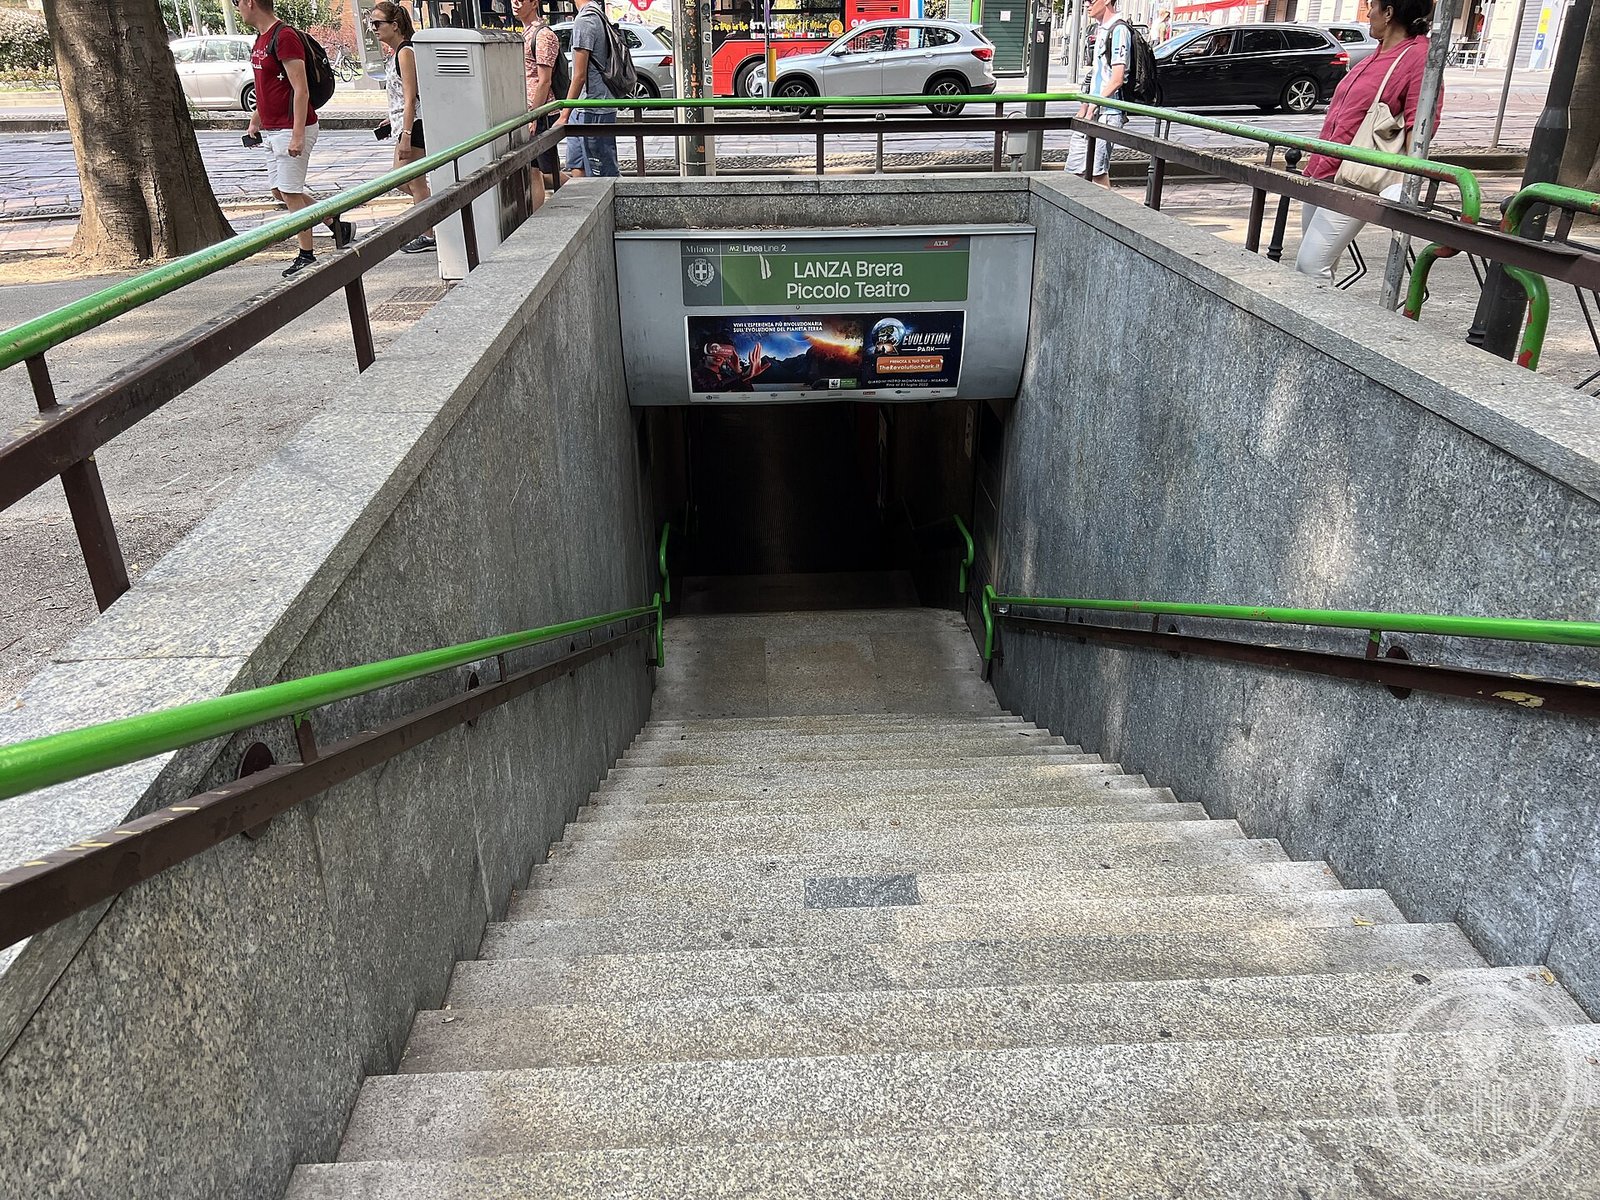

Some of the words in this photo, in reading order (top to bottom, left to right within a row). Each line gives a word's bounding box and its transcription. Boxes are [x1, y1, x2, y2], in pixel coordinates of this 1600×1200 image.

[686, 245, 714, 253] Milano
[763, 244, 779, 252] Line
[781, 244, 787, 252] 2
[794, 261, 852, 278] LANZA
[856, 261, 903, 277] Brera
[786, 282, 851, 299] Piccolo
[855, 281, 910, 298] Teatro
